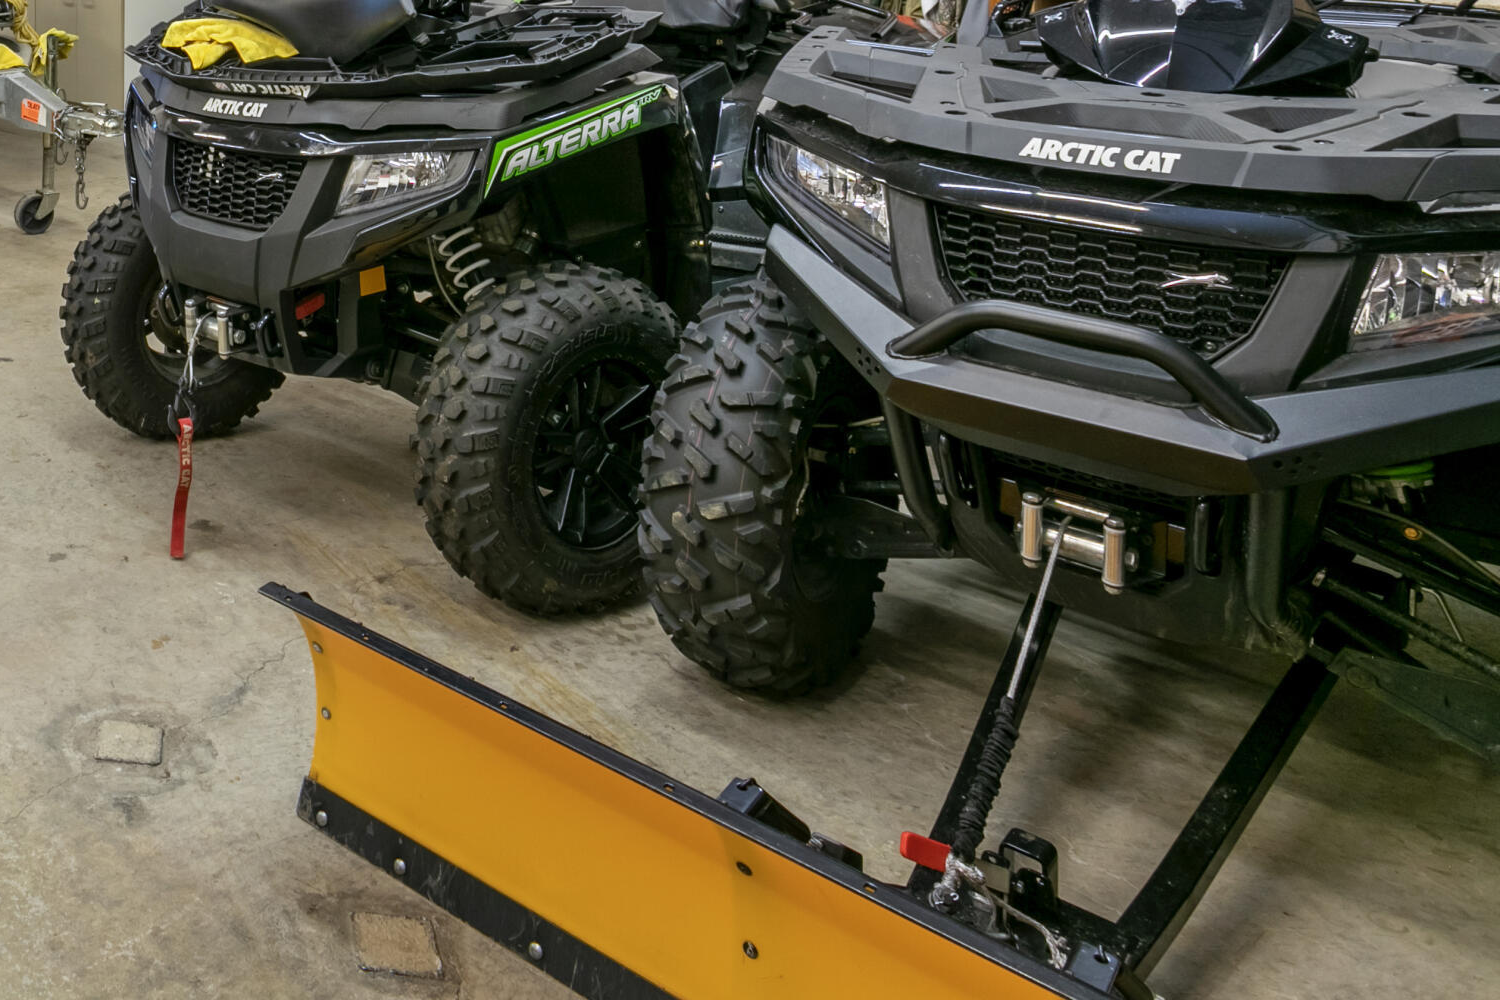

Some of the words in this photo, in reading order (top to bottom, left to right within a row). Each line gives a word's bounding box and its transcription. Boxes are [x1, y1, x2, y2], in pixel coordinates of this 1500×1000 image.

[230, 82, 256, 94] CAT
[257, 83, 311, 99] ARCTIC
[202, 97, 244, 116] ARCTIC
[242, 102, 268, 118] CAT
[635, 89, 661, 107] TRV
[504, 103, 640, 178] ALTERRA
[1018, 137, 1122, 168] ARCTIC
[1123, 149, 1182, 174] CAT
